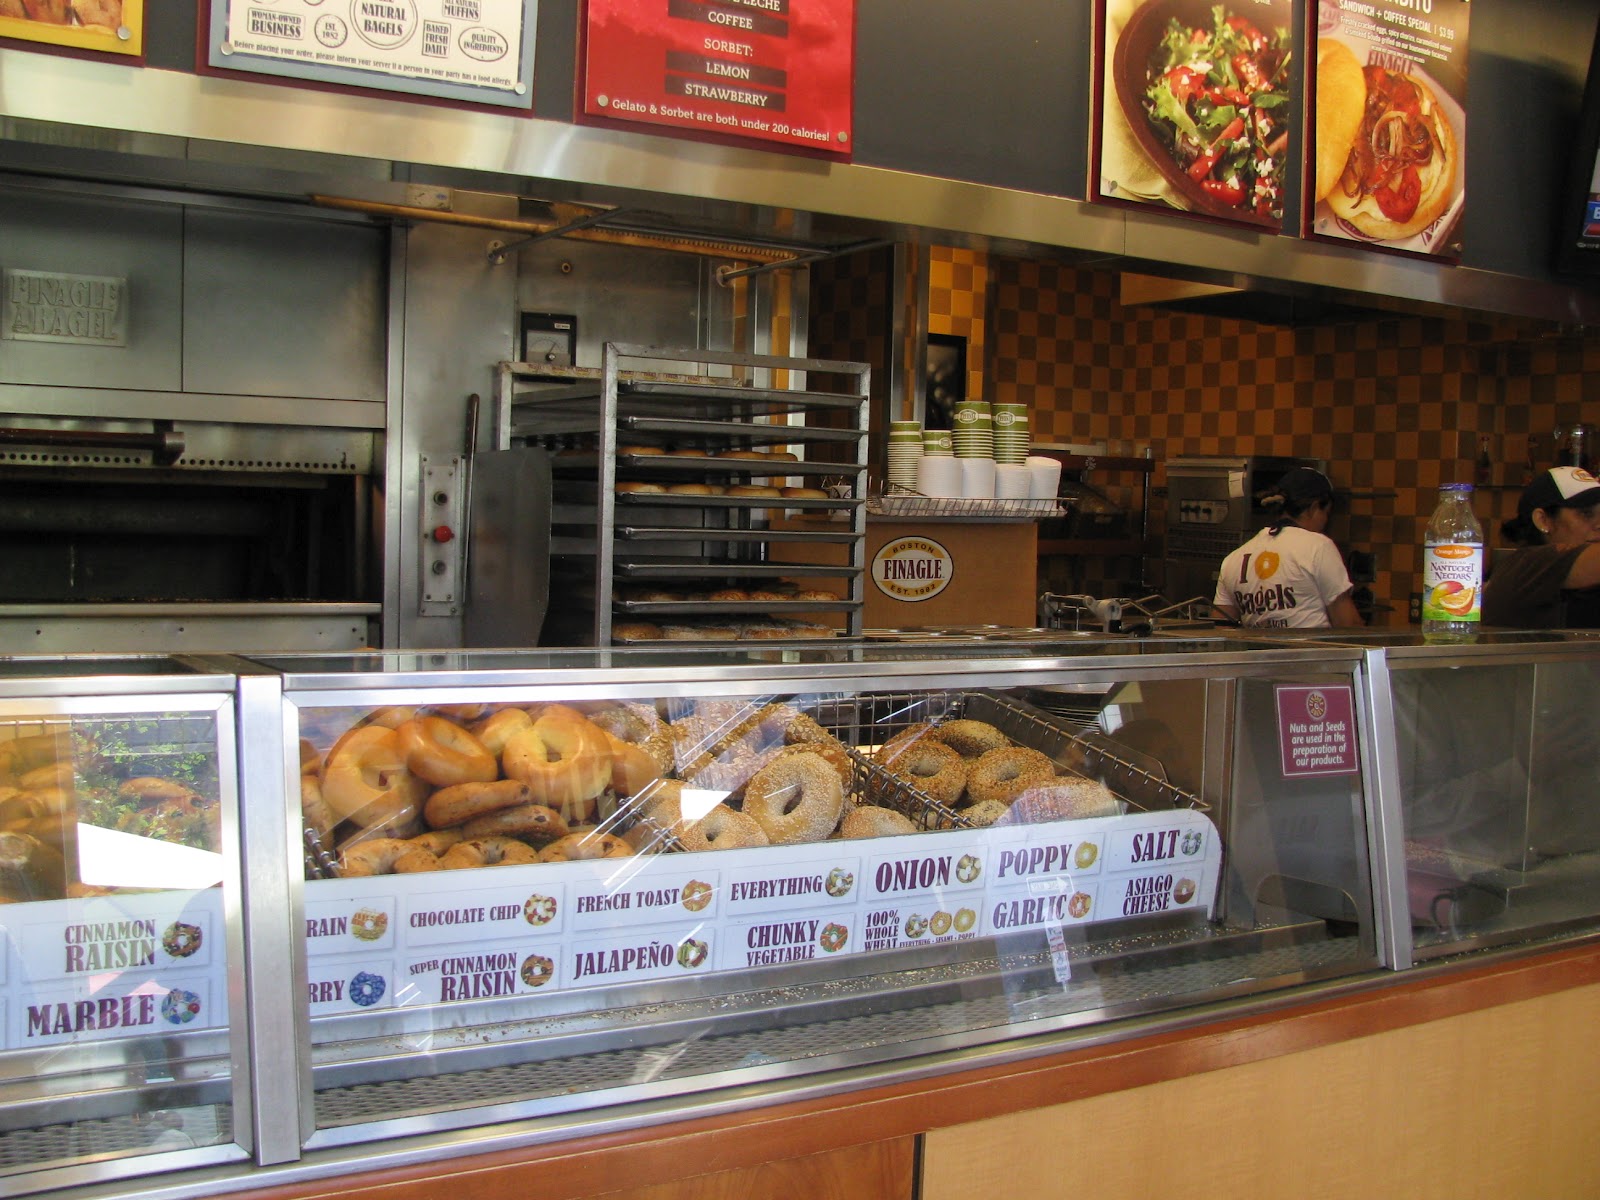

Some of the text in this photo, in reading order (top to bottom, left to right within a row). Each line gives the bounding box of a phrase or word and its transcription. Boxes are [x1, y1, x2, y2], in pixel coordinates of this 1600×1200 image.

[252, 10, 302, 24] WOMAN-OWNED
[361, 2, 407, 21] NATURAL
[444, 5, 479, 20] MUFFINS
[708, 11, 753, 30] COFFEE
[1340, 0, 1375, 17] SANDWICH
[1383, 10, 1407, 26] COFFEE
[1408, 17, 1432, 33] SPECIAL
[252, 20, 302, 38] BUSINESS
[364, 19, 403, 36] BAGELS
[426, 22, 449, 34] BAKED
[425, 34, 448, 44] FRESH
[463, 42, 504, 54] INGREDIENTS
[471, 33, 497, 44] QUALITY
[704, 38, 753, 57] SORBET:
[424, 44, 448, 56] DAILY
[234, 40, 254, 50] Before
[256, 44, 279, 54] placing
[280, 48, 295, 56] your
[316, 52, 336, 61] please
[358, 58, 372, 66] your
[373, 60, 391, 70] server
[404, 65, 422, 74] person
[432, 69, 444, 78] your
[446, 71, 460, 80] party
[706, 62, 750, 80] LEMON
[685, 83, 768, 107] STRAWBERRY
[612, 99, 830, 142] Gelato & Sorbet are both under 200 calories!
[893, 542, 934, 554] BOSTON
[884, 560, 942, 580] FINAGLE
[1240, 553, 1252, 584] I
[1430, 562, 1476, 572] NANTUCKET
[1435, 572, 1472, 581] NECTARS
[890, 584, 936, 596] EST. 1982
[1234, 584, 1297, 615] Bagels
[1290, 720, 1346, 734] Nuts and Seeds
[1292, 732, 1346, 744] are used in the
[1292, 743, 1346, 758] preparation of
[1296, 754, 1344, 768] our products.
[1131, 830, 1180, 864] SALT
[998, 844, 1073, 878] POPPY
[875, 856, 952, 893] ONION
[730, 875, 824, 902] EVERYTHING
[1126, 874, 1173, 898] ASIAGO
[576, 888, 680, 914] FRENCH TOAST
[1122, 892, 1171, 916] CHEESE
[410, 904, 522, 928] CHOCOLATE CHIP
[866, 909, 900, 928] 100%
[993, 894, 1068, 929] GARLIC
[64, 919, 156, 945] CINNAMON
[747, 920, 820, 949] CHUNKY
[865, 925, 899, 940] WHOLE
[864, 938, 898, 952] WHEAT
[64, 938, 156, 973] RAISIN
[409, 952, 518, 976] SUPER CINNAMON
[573, 940, 674, 980] JALAPEÑO
[746, 944, 816, 966] VEGETABLE
[440, 970, 517, 1002] RAISIN
[27, 994, 156, 1038] MARBLE
